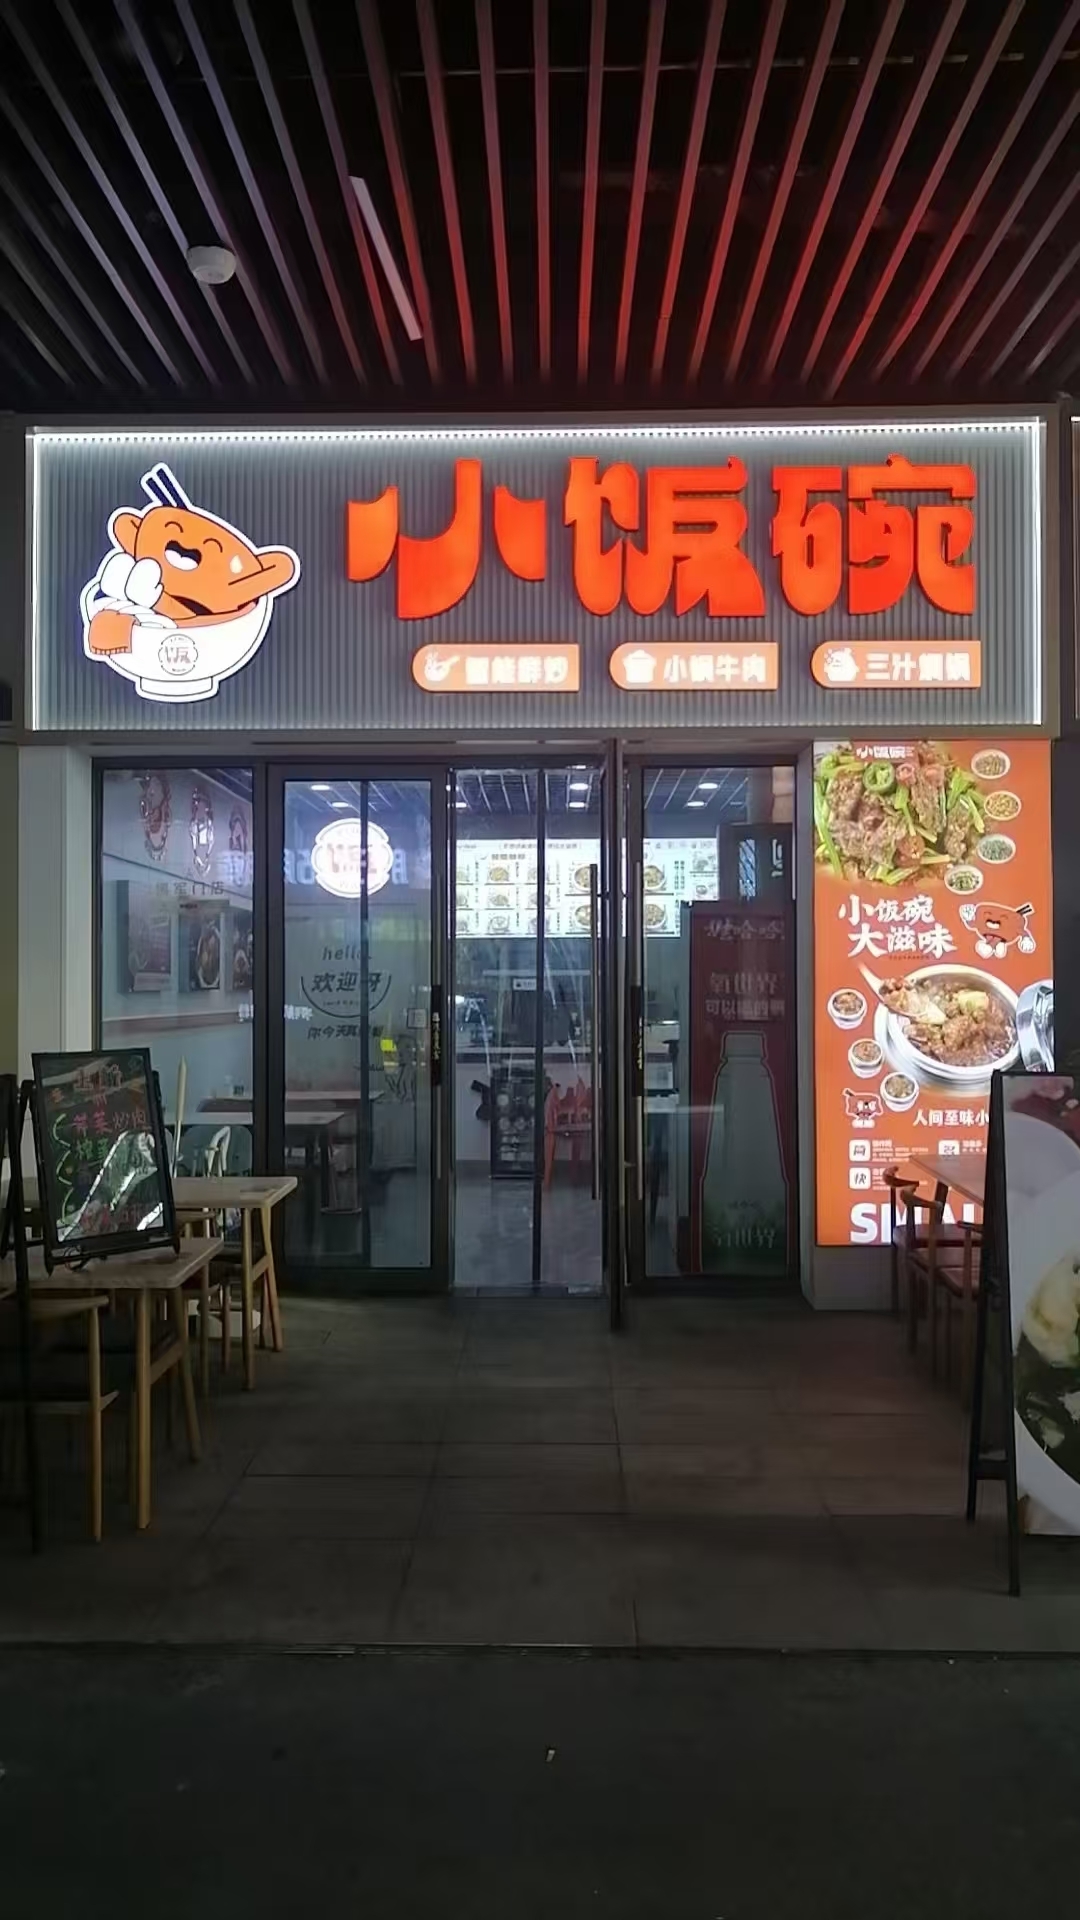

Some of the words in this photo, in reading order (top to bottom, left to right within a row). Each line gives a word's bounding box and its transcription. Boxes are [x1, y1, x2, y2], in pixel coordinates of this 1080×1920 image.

[347, 455, 976, 619] 小饭碗
[838, 894, 935, 926] 小饭碗
[322, 945, 373, 961] hell
[848, 922, 958, 959] 大滋味
[307, 1024, 384, 1040] 你今天真
